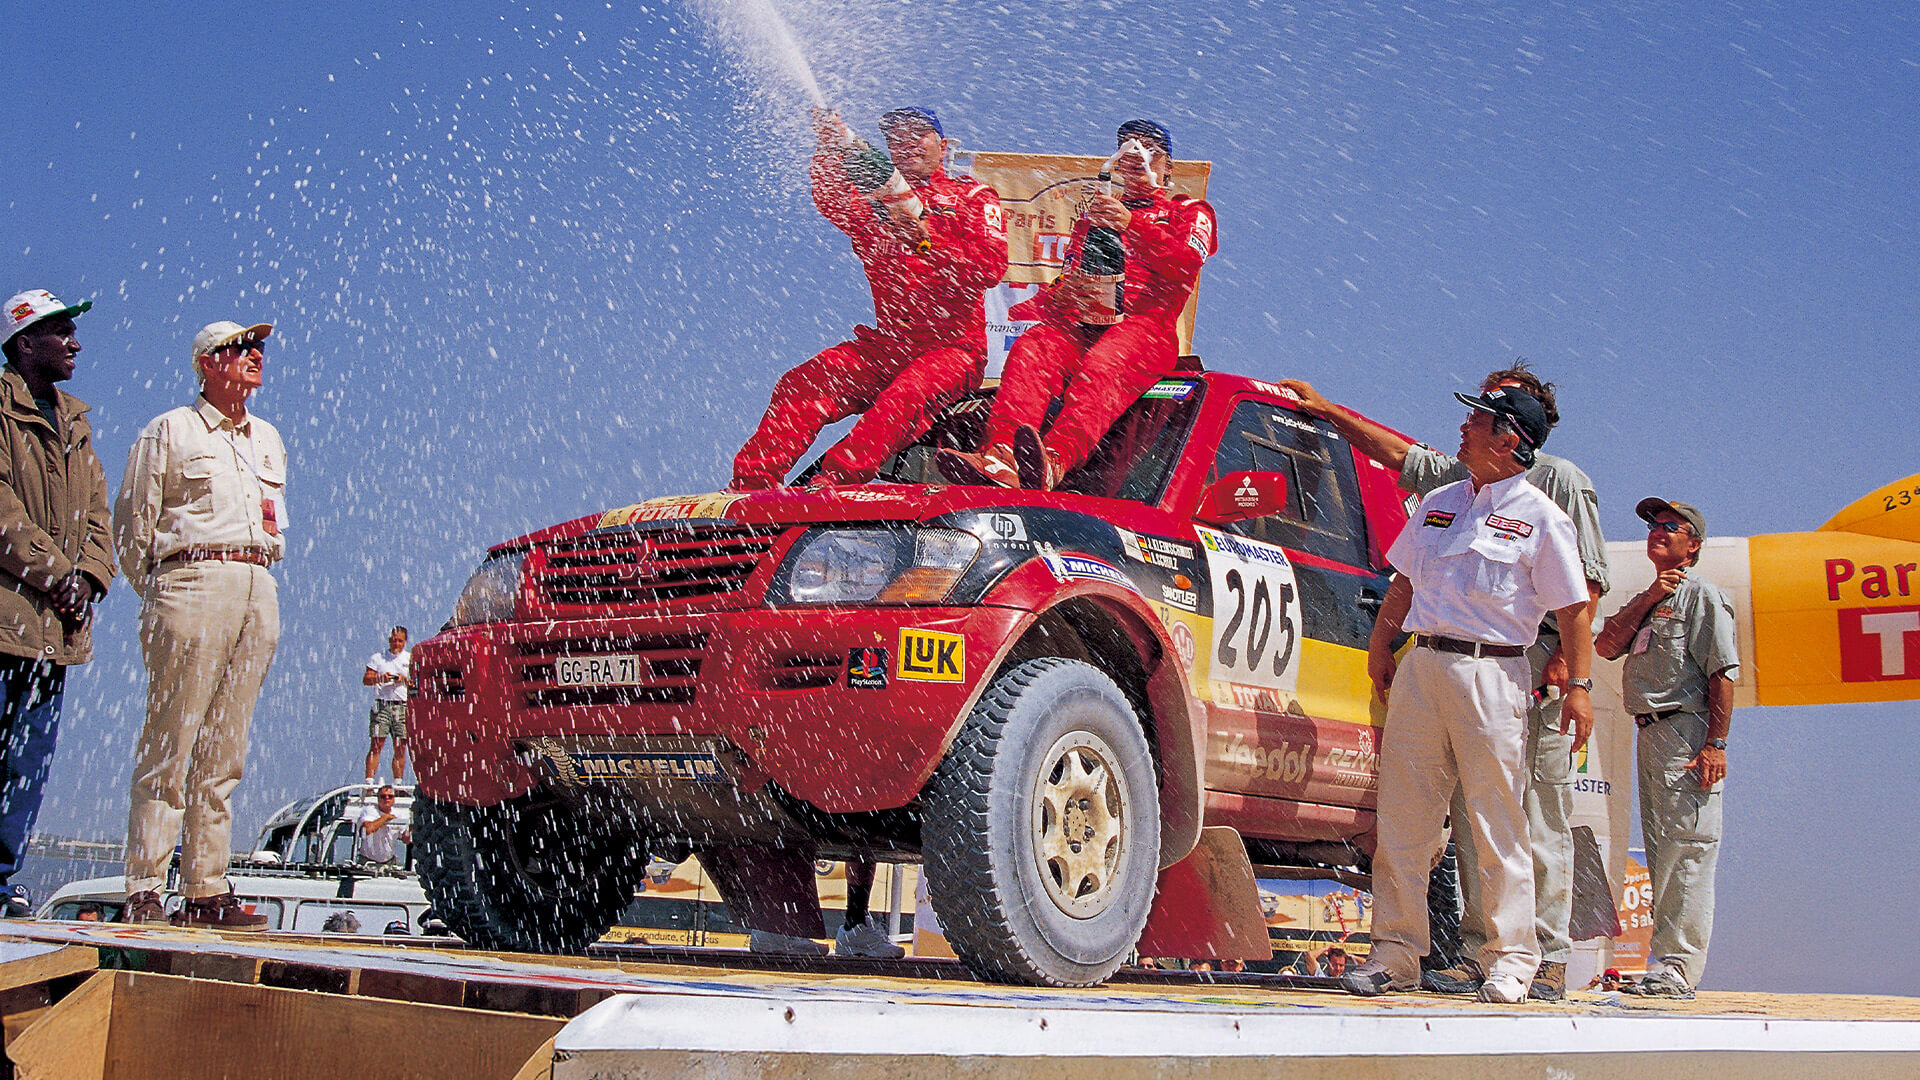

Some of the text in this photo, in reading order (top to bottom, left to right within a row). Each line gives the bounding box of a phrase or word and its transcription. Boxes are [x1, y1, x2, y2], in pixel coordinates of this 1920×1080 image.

[1004, 208, 1055, 229] Paris
[629, 503, 693, 523] TOTAL
[995, 513, 1013, 540] hp
[1214, 536, 1289, 568] EUROMASTER
[1825, 558, 1918, 601] Par
[1218, 568, 1295, 677] 205
[561, 658, 636, 684] GG-RA 71
[851, 678, 882, 687] PlayStation
[1231, 685, 1284, 714] TOTAL
[582, 759, 717, 775] MICHELIN
